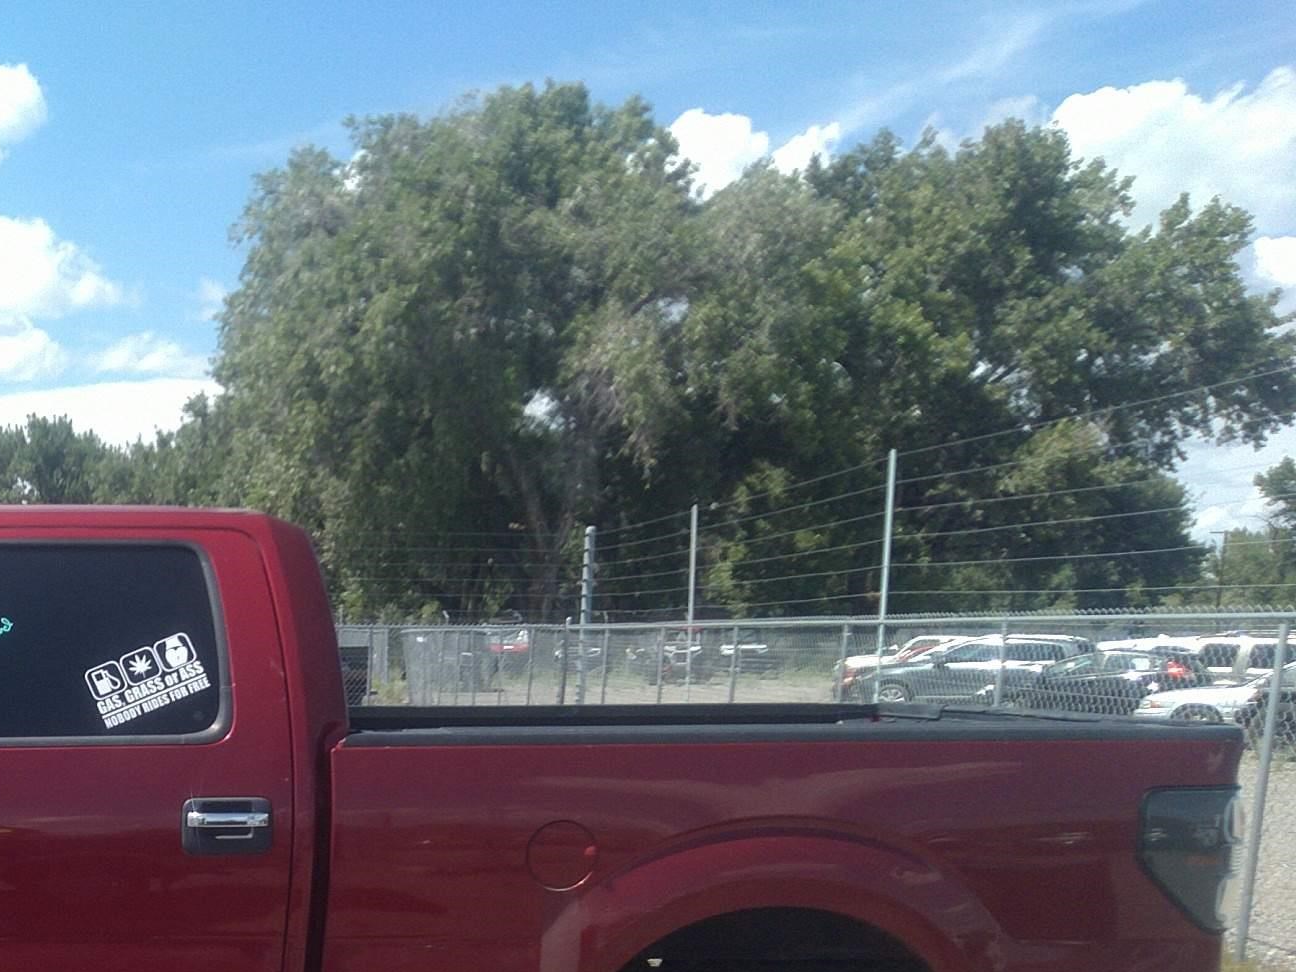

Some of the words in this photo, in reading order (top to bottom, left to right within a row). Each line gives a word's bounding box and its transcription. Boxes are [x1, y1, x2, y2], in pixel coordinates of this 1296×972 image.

[103, 704, 143, 729] NOBODY
[142, 695, 171, 713] RIDES
[169, 687, 190, 702] FOR
[188, 677, 212, 695] FREE
[124, 676, 165, 703] GRASS
[179, 660, 205, 682] ASS
